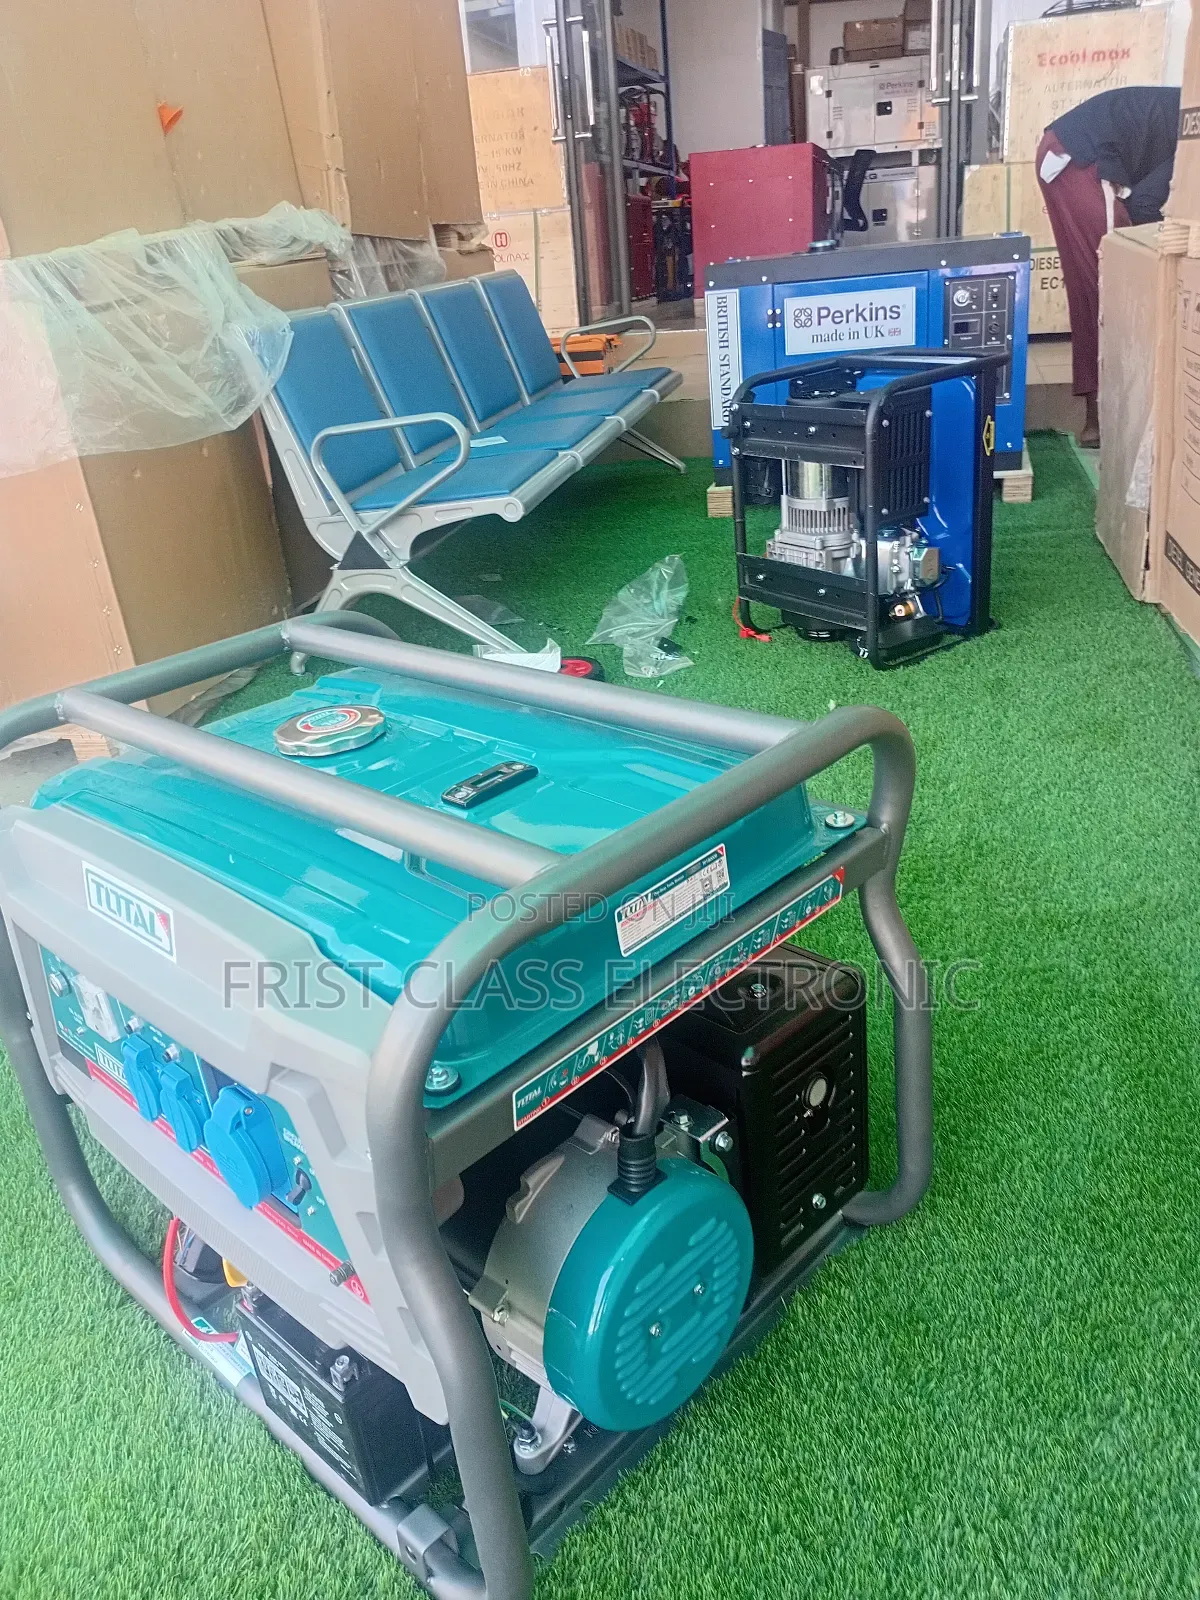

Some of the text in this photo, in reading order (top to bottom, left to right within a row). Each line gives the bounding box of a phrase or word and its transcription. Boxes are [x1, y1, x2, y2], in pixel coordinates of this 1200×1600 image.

[1044, 76, 1128, 94] ALTERNATOR
[716, 295, 730, 350] BRITISH
[816, 302, 901, 326] Perkins
[811, 325, 885, 344] made in UK
[90, 877, 163, 942] TOTAL
[517, 1086, 542, 1108] TOTAL
